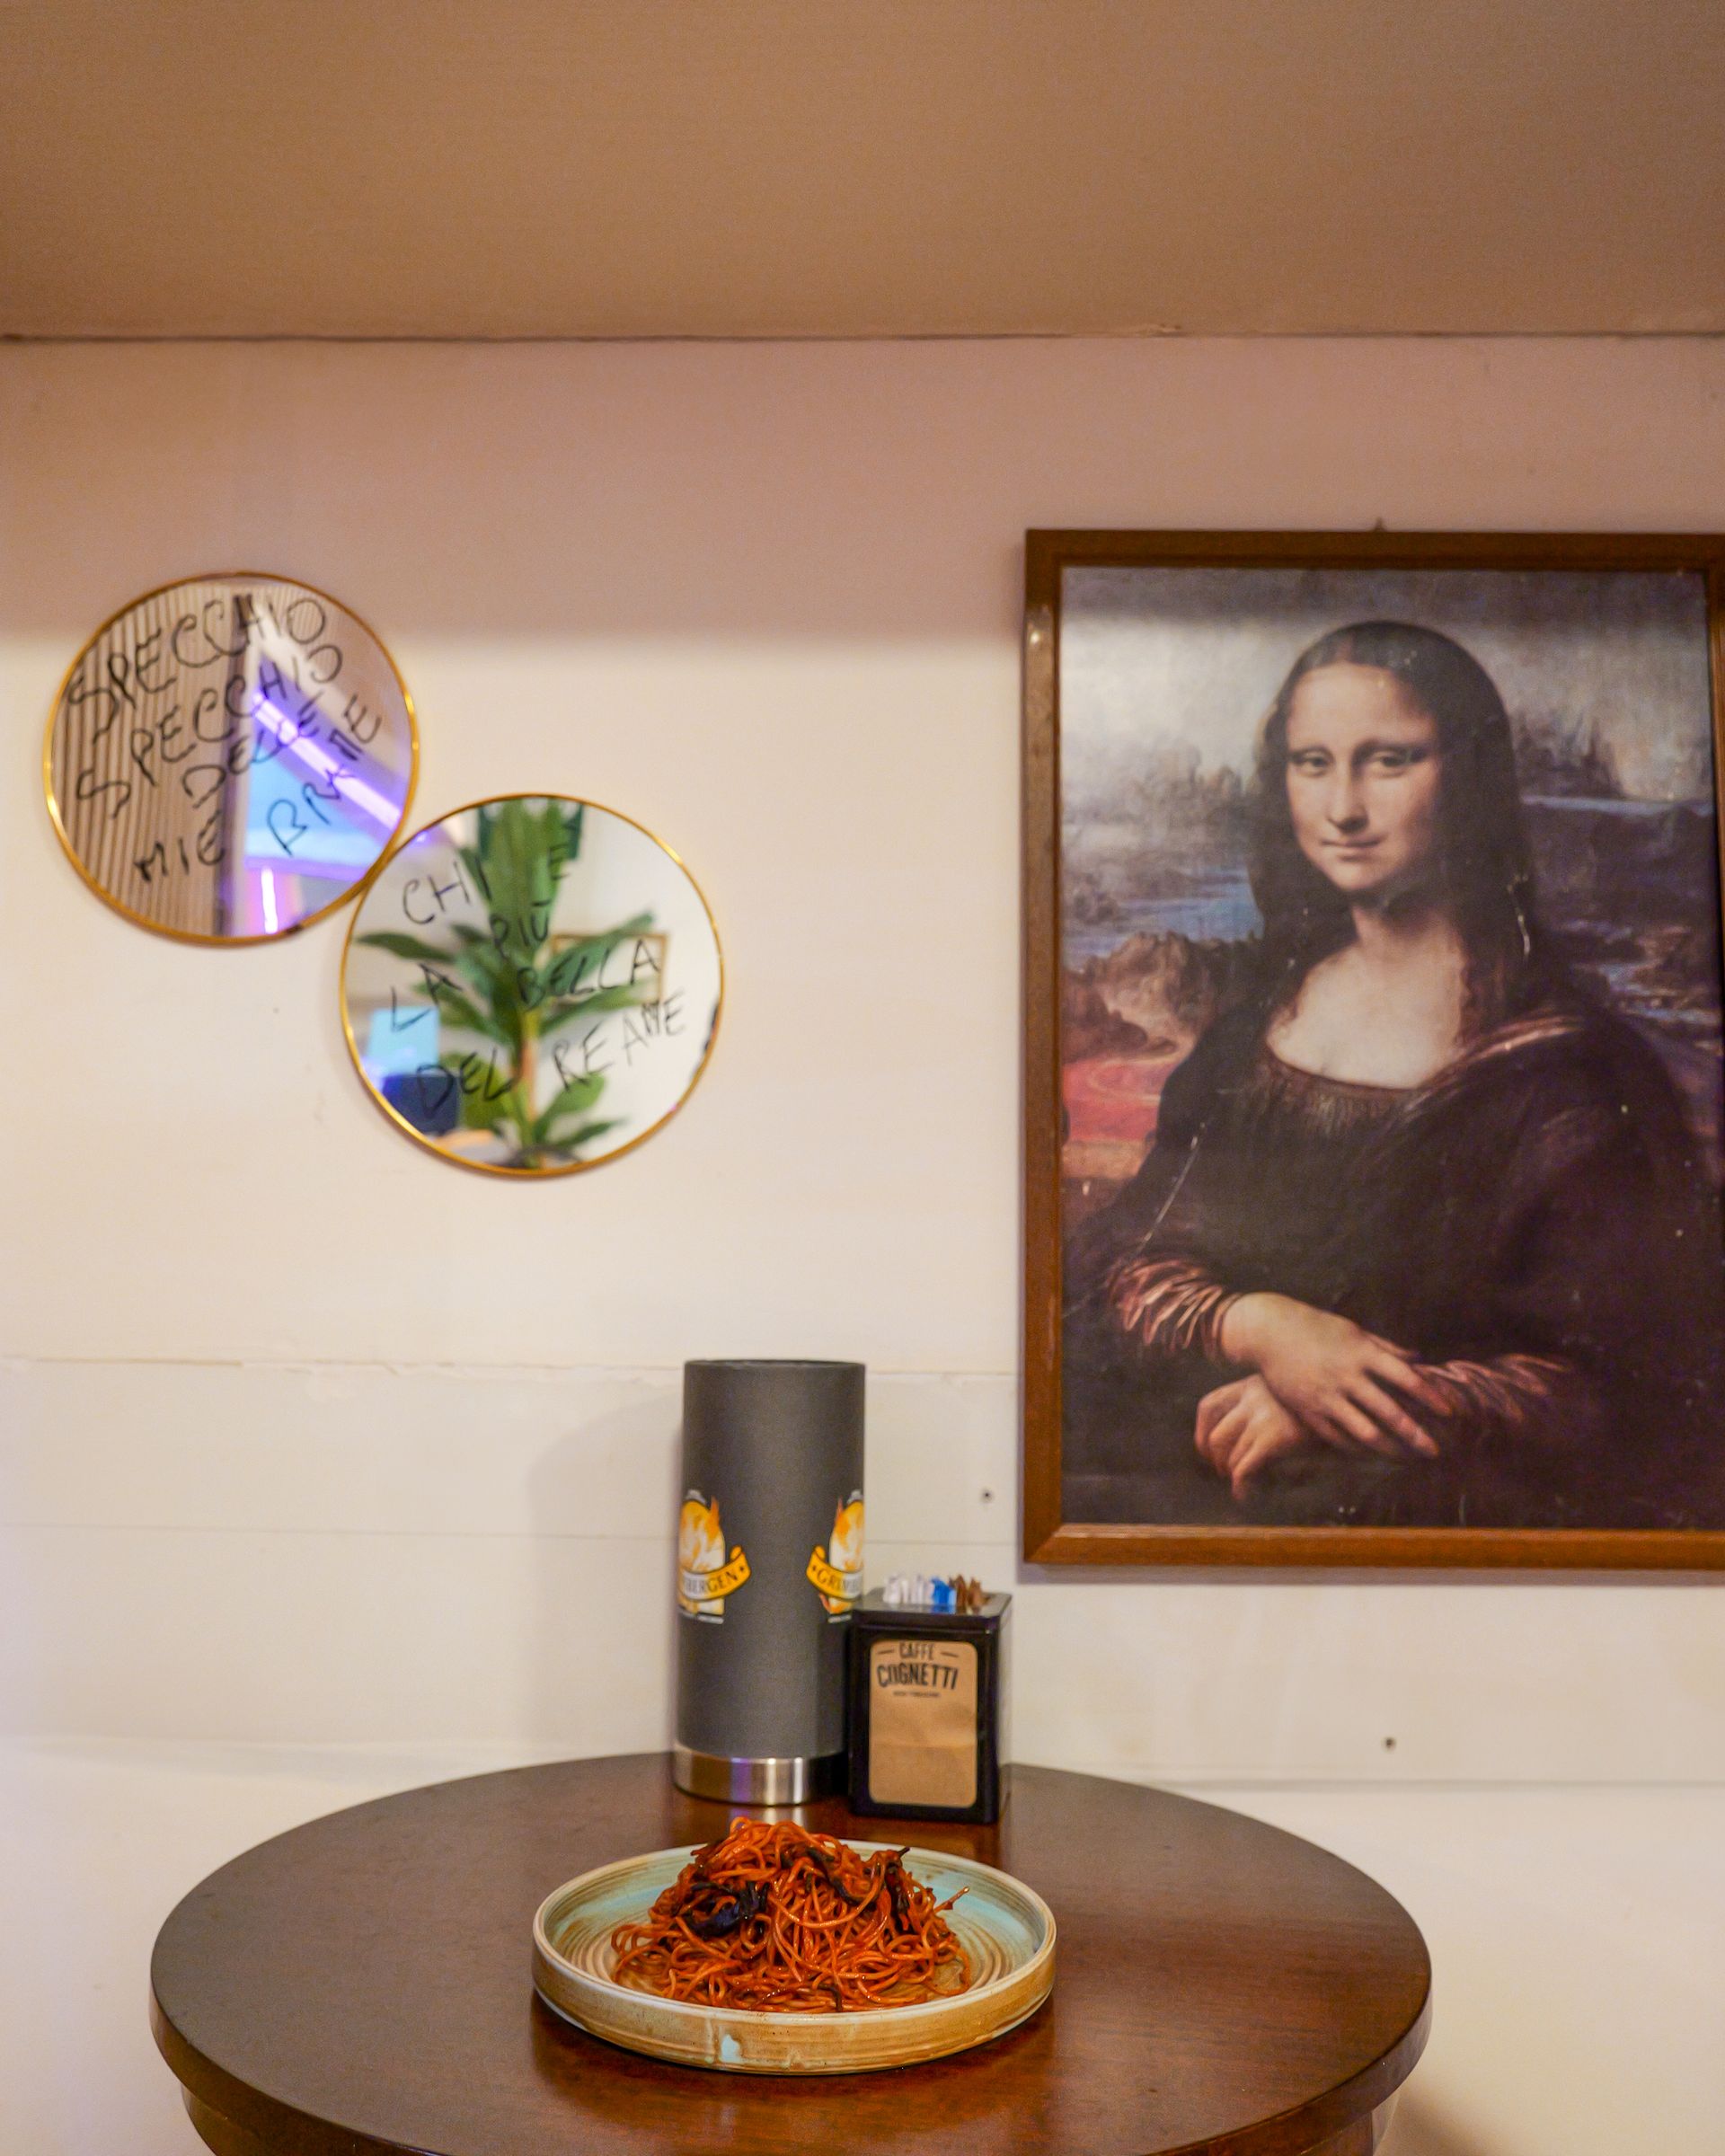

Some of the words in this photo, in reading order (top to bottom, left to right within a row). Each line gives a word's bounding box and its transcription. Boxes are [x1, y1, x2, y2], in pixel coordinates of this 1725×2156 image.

[68, 594, 326, 745] SPECCHIO
[76, 644, 342, 818] SPECCHIO
[134, 808, 226, 881] MIE
[402, 856, 492, 925] CHI
[390, 963, 463, 1032] LA
[517, 939, 661, 1012] BELLA
[416, 1047, 517, 1119] DEL
[552, 992, 686, 1092] REAME
[877, 1662, 960, 1690] COGNETTI
